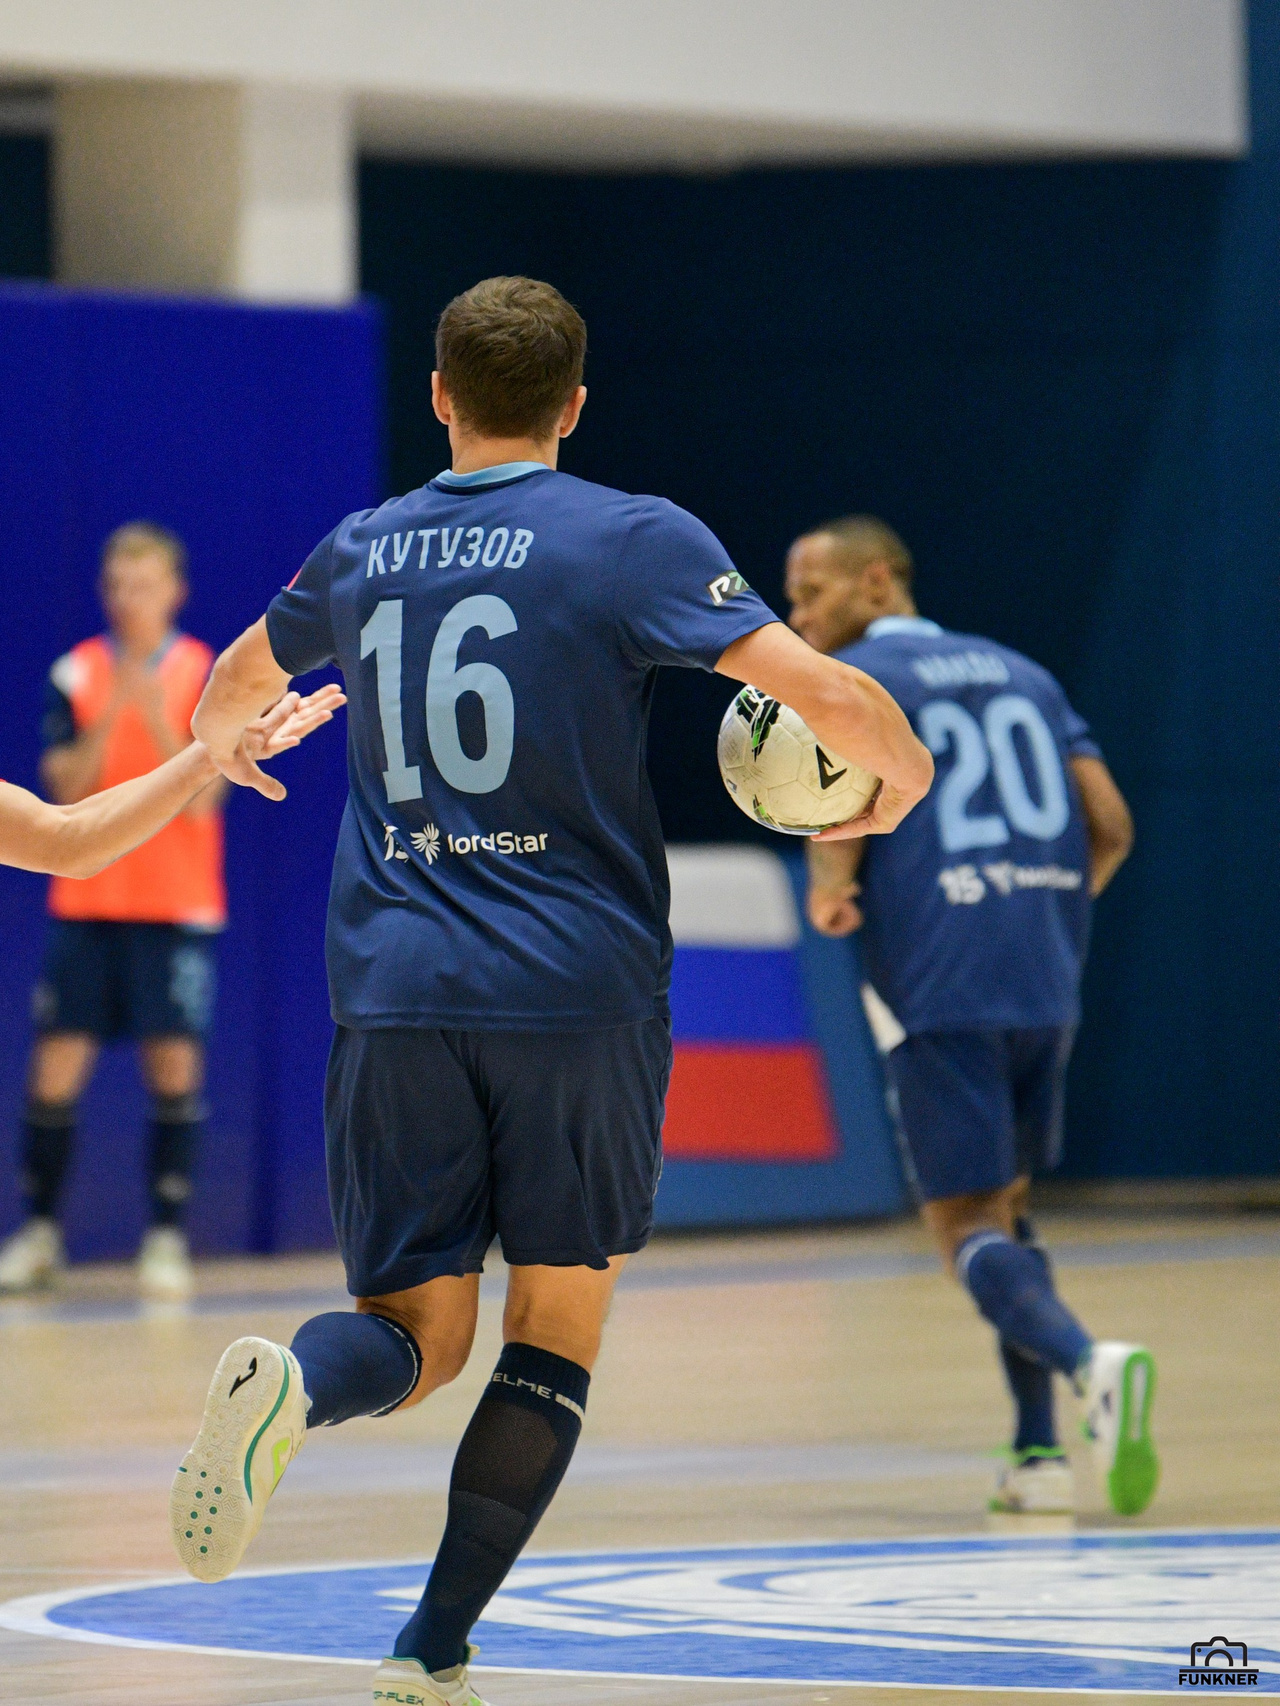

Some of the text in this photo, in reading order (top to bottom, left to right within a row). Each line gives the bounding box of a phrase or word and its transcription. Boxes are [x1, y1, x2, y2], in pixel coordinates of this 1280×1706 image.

[366, 527, 534, 578] КУТУЗОВ
[360, 594, 518, 804] 16
[921, 694, 1069, 852] 20
